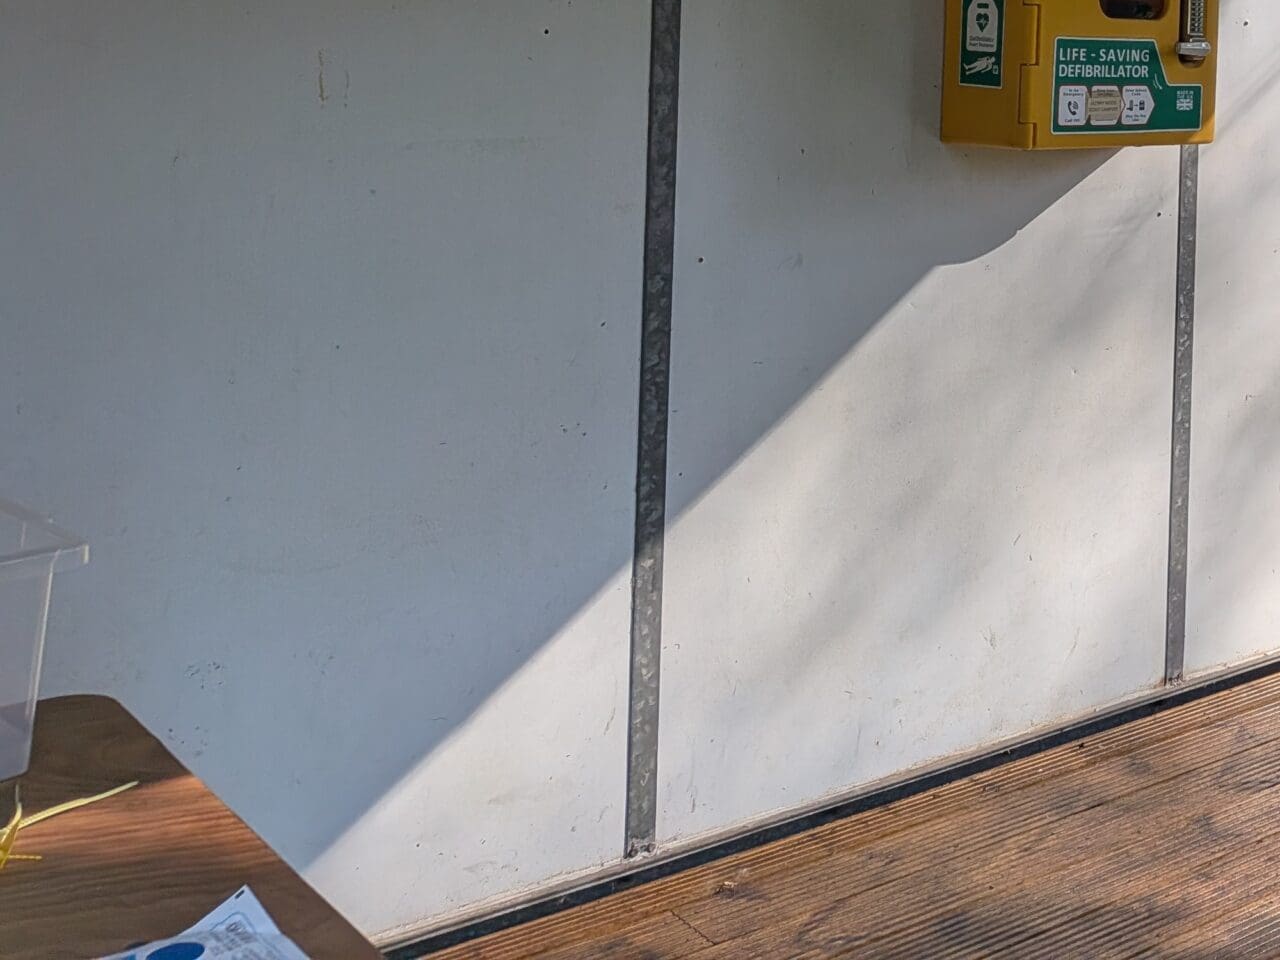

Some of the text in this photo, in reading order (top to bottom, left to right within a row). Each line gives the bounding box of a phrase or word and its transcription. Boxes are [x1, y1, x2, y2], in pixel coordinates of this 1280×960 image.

[1059, 47, 1087, 61] LIFE
[1099, 48, 1150, 63] SAVING
[1058, 63, 1149, 78] DEFIBRILLATOR
